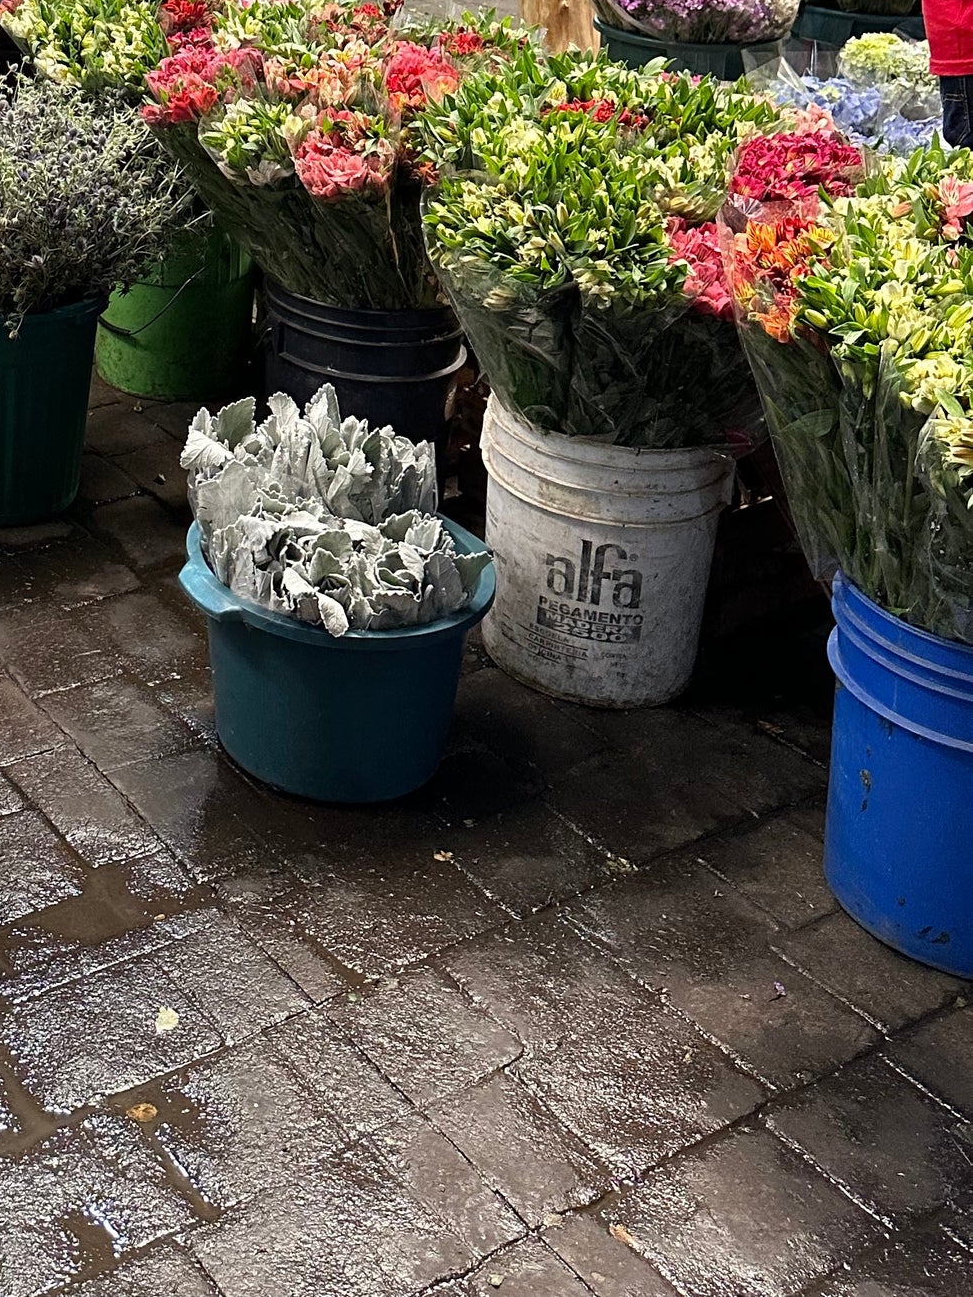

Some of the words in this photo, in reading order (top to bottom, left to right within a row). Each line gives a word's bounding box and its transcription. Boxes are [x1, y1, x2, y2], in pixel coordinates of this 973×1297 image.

[546, 538, 643, 609] alfa
[539, 595, 644, 625] PEGAMENTO
[546, 610, 633, 635] MADERA
[528, 632, 588, 658] CARPINTERIA
[529, 622, 569, 644] ESCUELA
